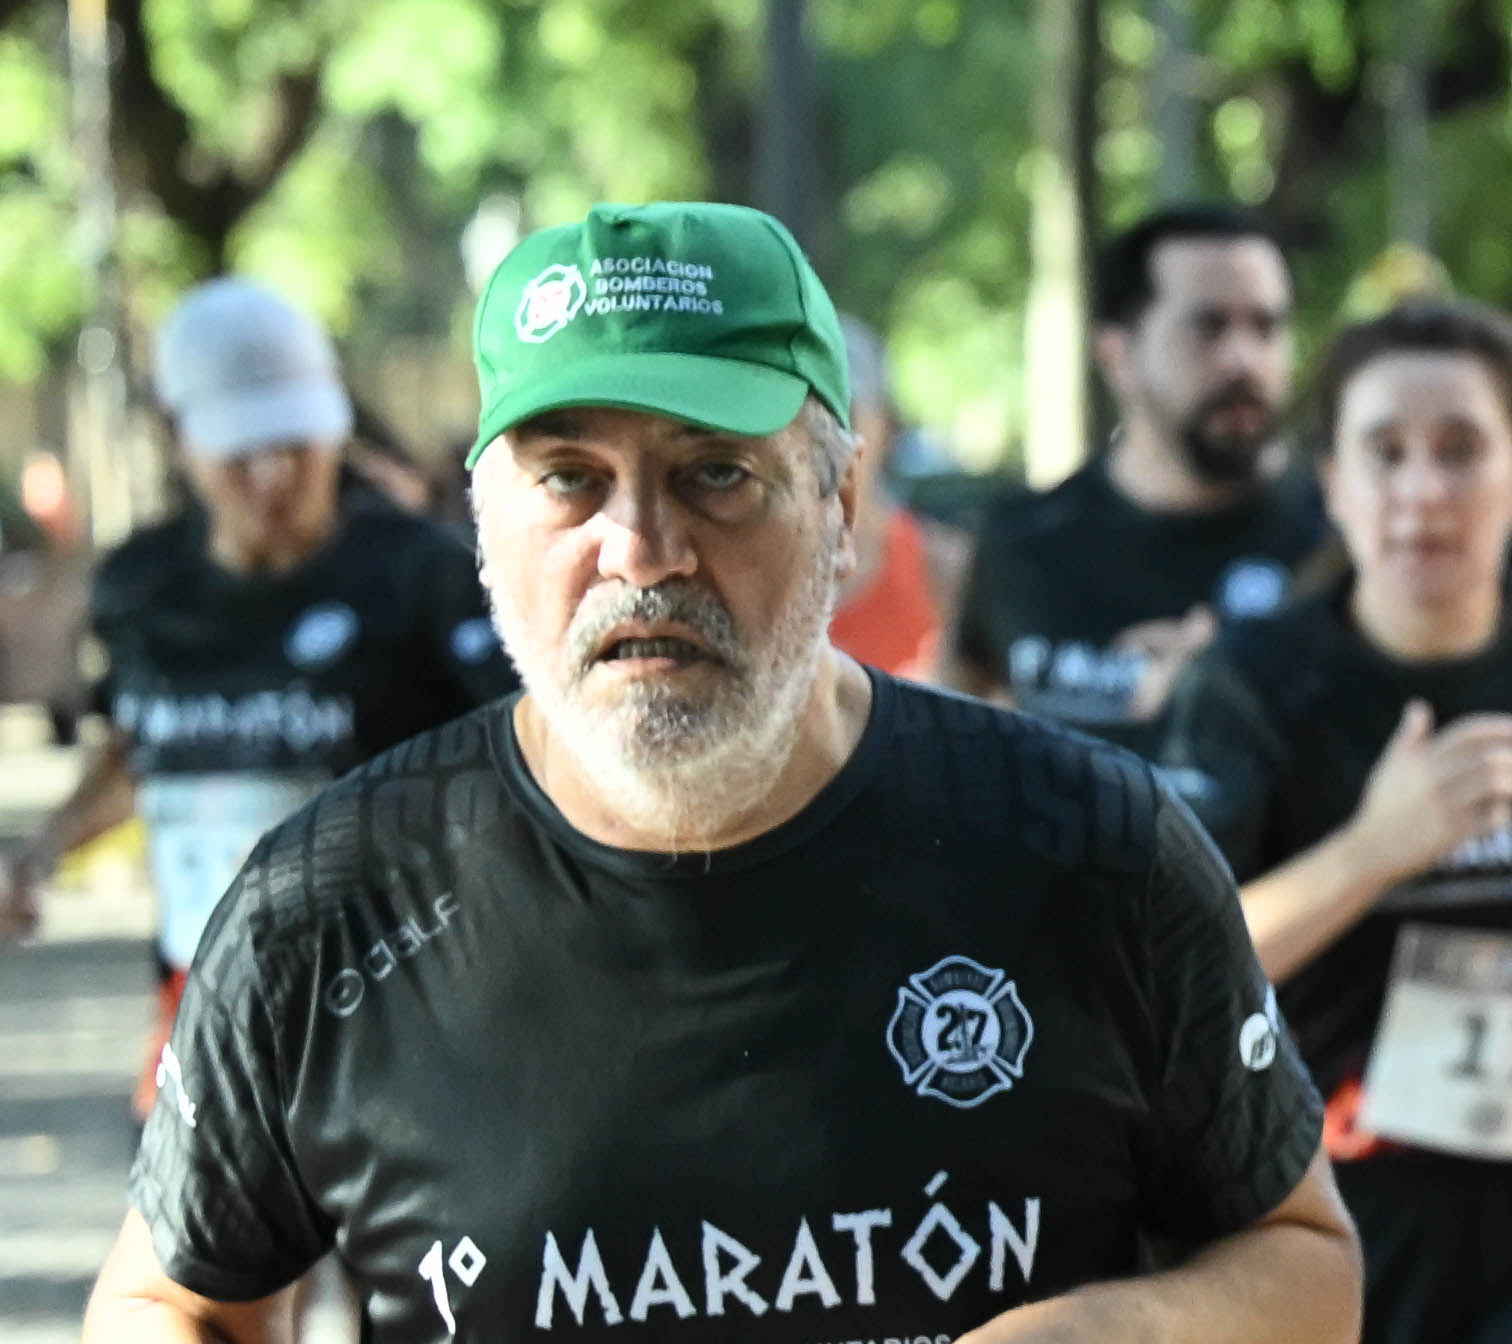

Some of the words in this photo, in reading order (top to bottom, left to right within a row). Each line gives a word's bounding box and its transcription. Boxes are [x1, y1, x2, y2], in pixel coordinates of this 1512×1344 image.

[595, 276, 708, 297] BOMBEROS
[584, 296, 724, 317] VOLUNTARIOS
[935, 1003, 988, 1052] 27
[534, 1169, 1041, 1332] MARATÓN
